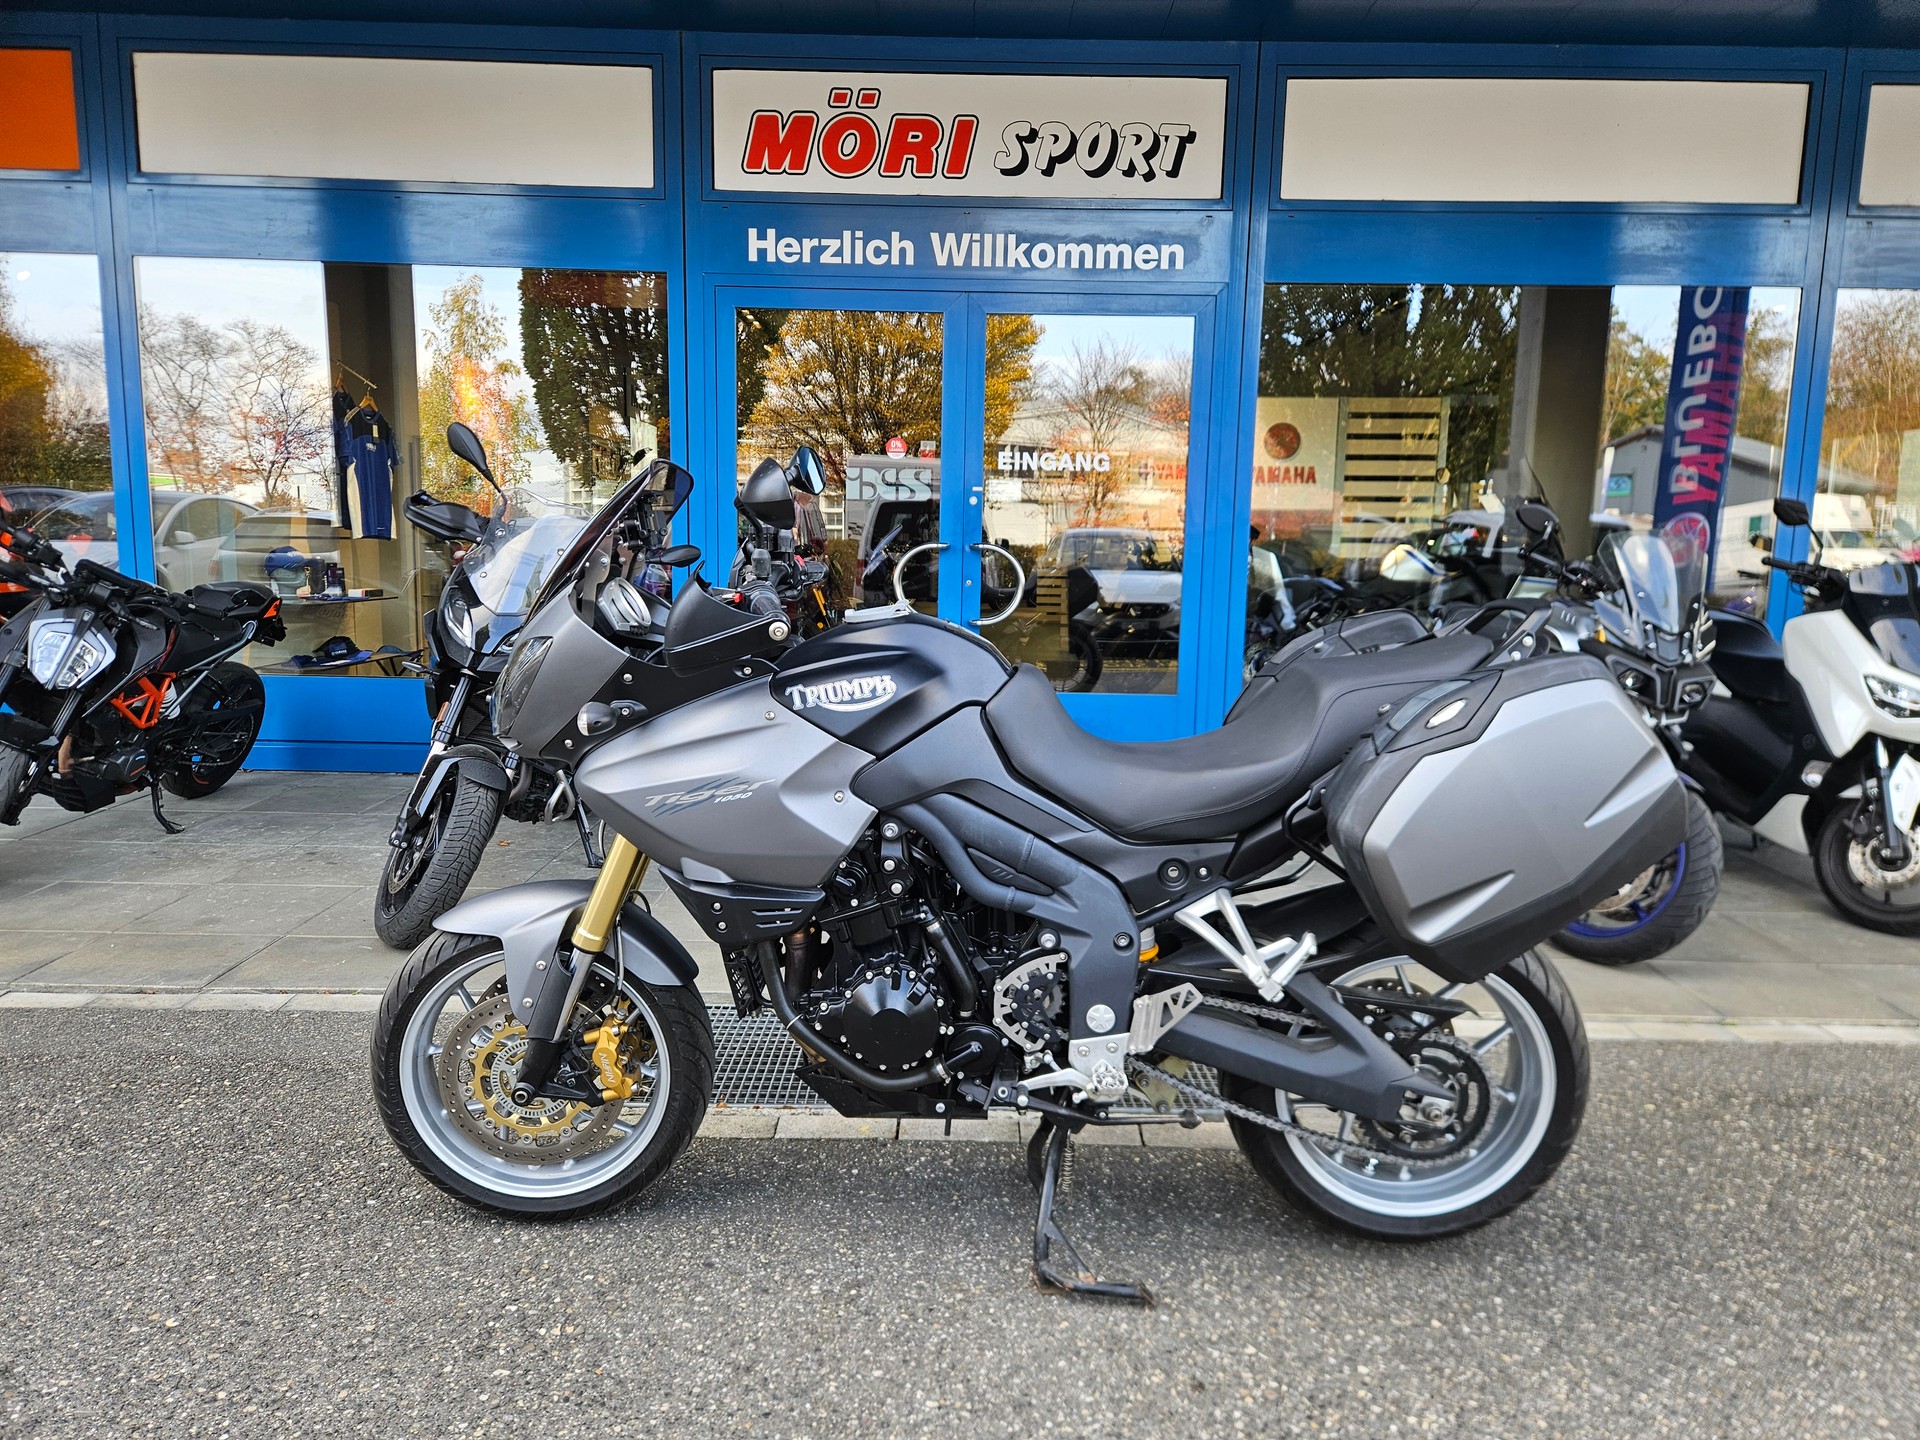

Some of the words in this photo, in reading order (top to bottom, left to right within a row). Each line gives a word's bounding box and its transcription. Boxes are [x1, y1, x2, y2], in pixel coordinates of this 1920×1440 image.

[741, 87, 979, 180] MÖRI
[993, 120, 1197, 183] SPORT
[747, 228, 915, 266] Herzlich
[930, 232, 1184, 271] Willkommen
[997, 451, 1112, 473] EINGANG
[1252, 466, 1317, 485] AMAHA
[785, 675, 896, 711] TRIUMPH
[644, 778, 777, 806] Tiger
[713, 791, 753, 804] 1050
